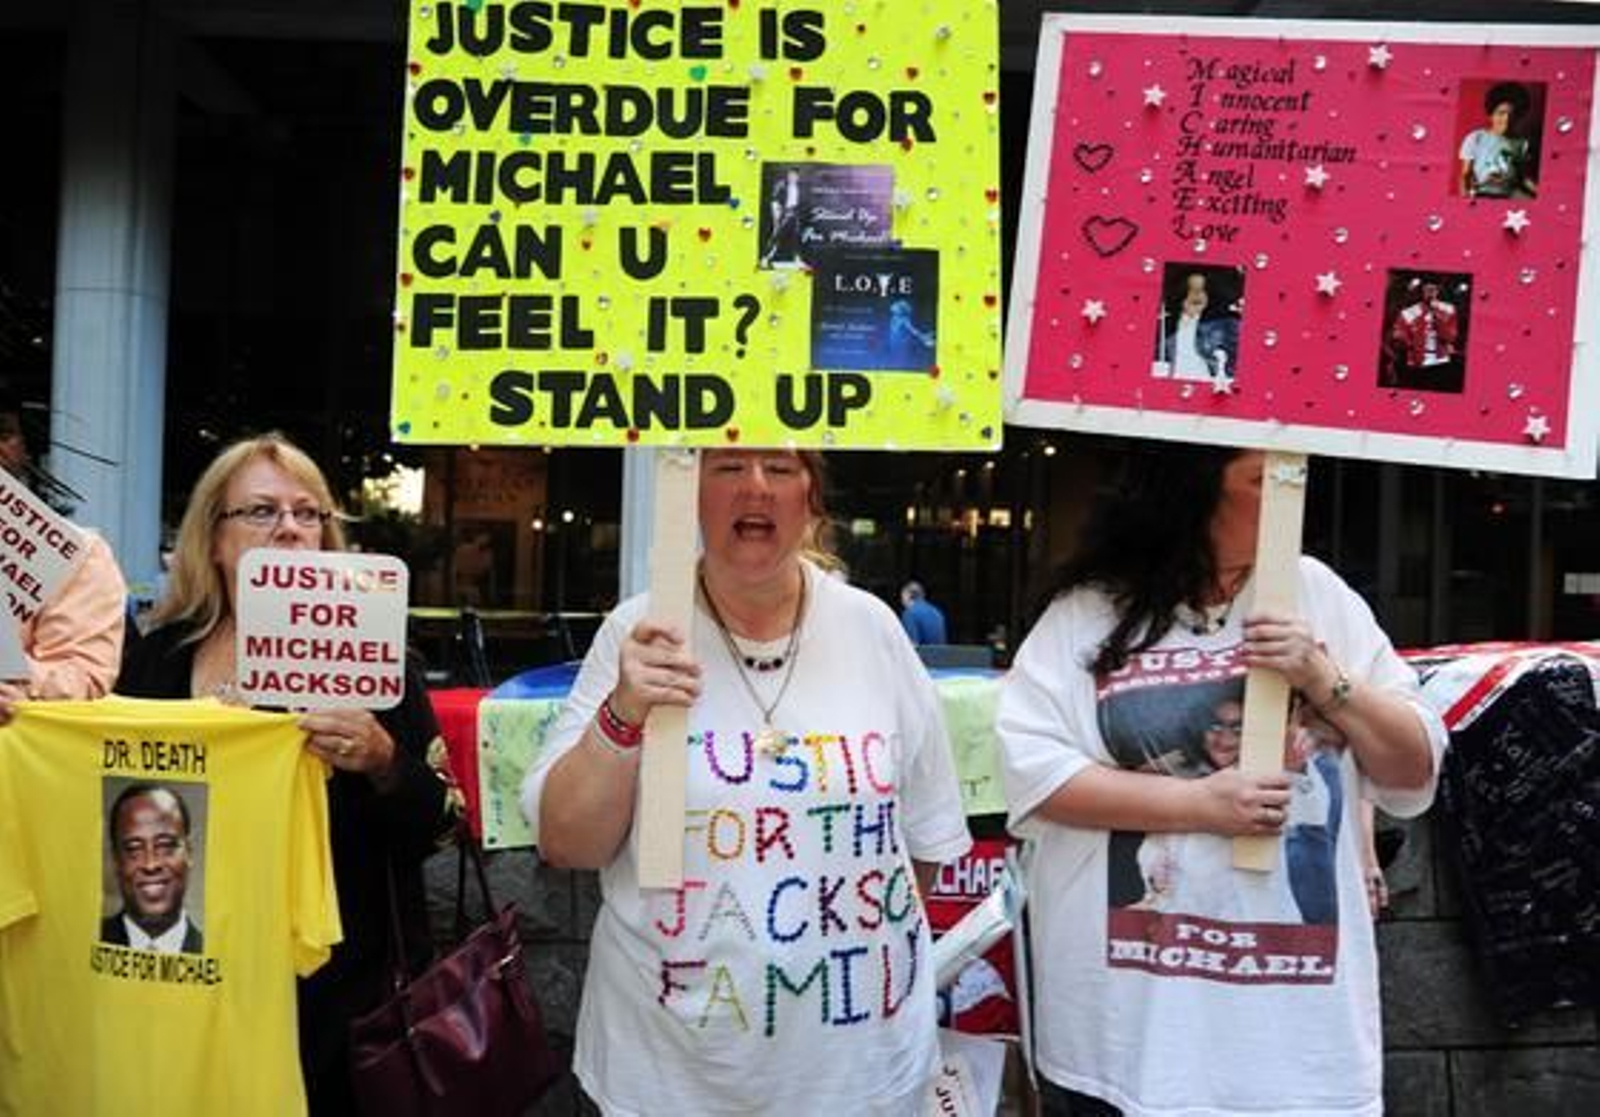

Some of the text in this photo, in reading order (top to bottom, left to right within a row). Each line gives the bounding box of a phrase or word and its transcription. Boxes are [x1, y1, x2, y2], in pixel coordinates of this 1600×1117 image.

[427, 2, 826, 61] JUSTICE IS
[413, 79, 936, 142] OVERDUE FOR
[418, 150, 731, 204] MICHAEL
[412, 225, 667, 280] CAN U
[410, 293, 761, 358] FEEL IT?
[489, 370, 872, 430] STAND UP
[0, 554, 43, 603] AEL
[251, 564, 398, 593] JUSTICE
[290, 602, 358, 629] FOR
[246, 636, 400, 664] MICHAEL
[241, 669, 401, 697] JACKSON
[103, 740, 207, 774] DR. DEATH
[687, 730, 894, 794] USTIC
[655, 865, 917, 944] JACKSO
[1109, 938, 1334, 977] MICHAEL
[1176, 923, 1258, 949] FOR
[133, 952, 157, 982] FOR
[160, 954, 223, 986] MICHAEL
